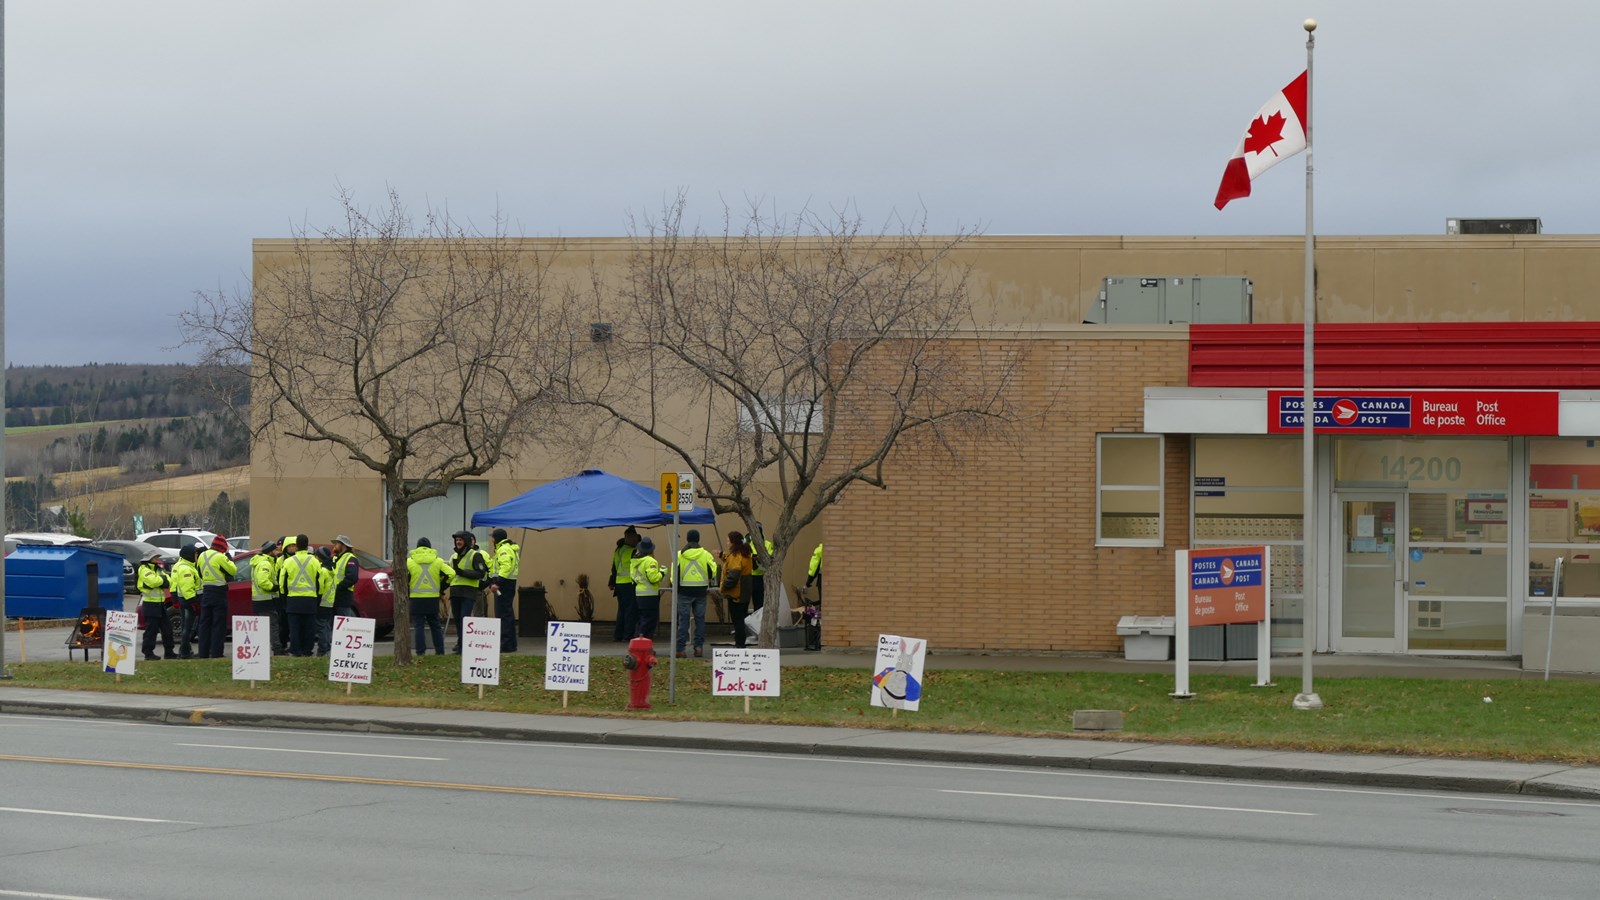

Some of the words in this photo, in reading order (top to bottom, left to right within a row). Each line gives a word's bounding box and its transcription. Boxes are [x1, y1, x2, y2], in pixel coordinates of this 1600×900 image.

[1285, 401, 1324, 409] POSES
[1361, 401, 1405, 410] CANADA
[1422, 400, 1459, 413] Bureau
[1476, 400, 1499, 413] Post
[1285, 415, 1329, 424] CANDA
[1361, 416, 1388, 424] POST
[1422, 414, 1436, 425] de
[1437, 415, 1466, 428] poste
[1476, 414, 1506, 426] Office
[1380, 455, 1462, 482] 14200
[1194, 561, 1217, 570] POSTES
[1235, 559, 1259, 568] CANADA
[1194, 576, 1219, 586] CANADA
[1235, 574, 1251, 583] POST
[1194, 594, 1213, 604] Bureau
[1234, 591, 1246, 601] Post
[1194, 605, 1202, 615] de
[1202, 605, 1216, 617] poste
[1234, 602, 1249, 612] Office
[235, 617, 259, 631] PAYÉ
[243, 631, 251, 645] À
[345, 634, 363, 650] 25
[236, 645, 261, 660] 85%
[562, 638, 579, 653] 25
[333, 658, 369, 670] SERVICE
[551, 662, 585, 673] SERVICE
[716, 675, 769, 692] Lock-out
